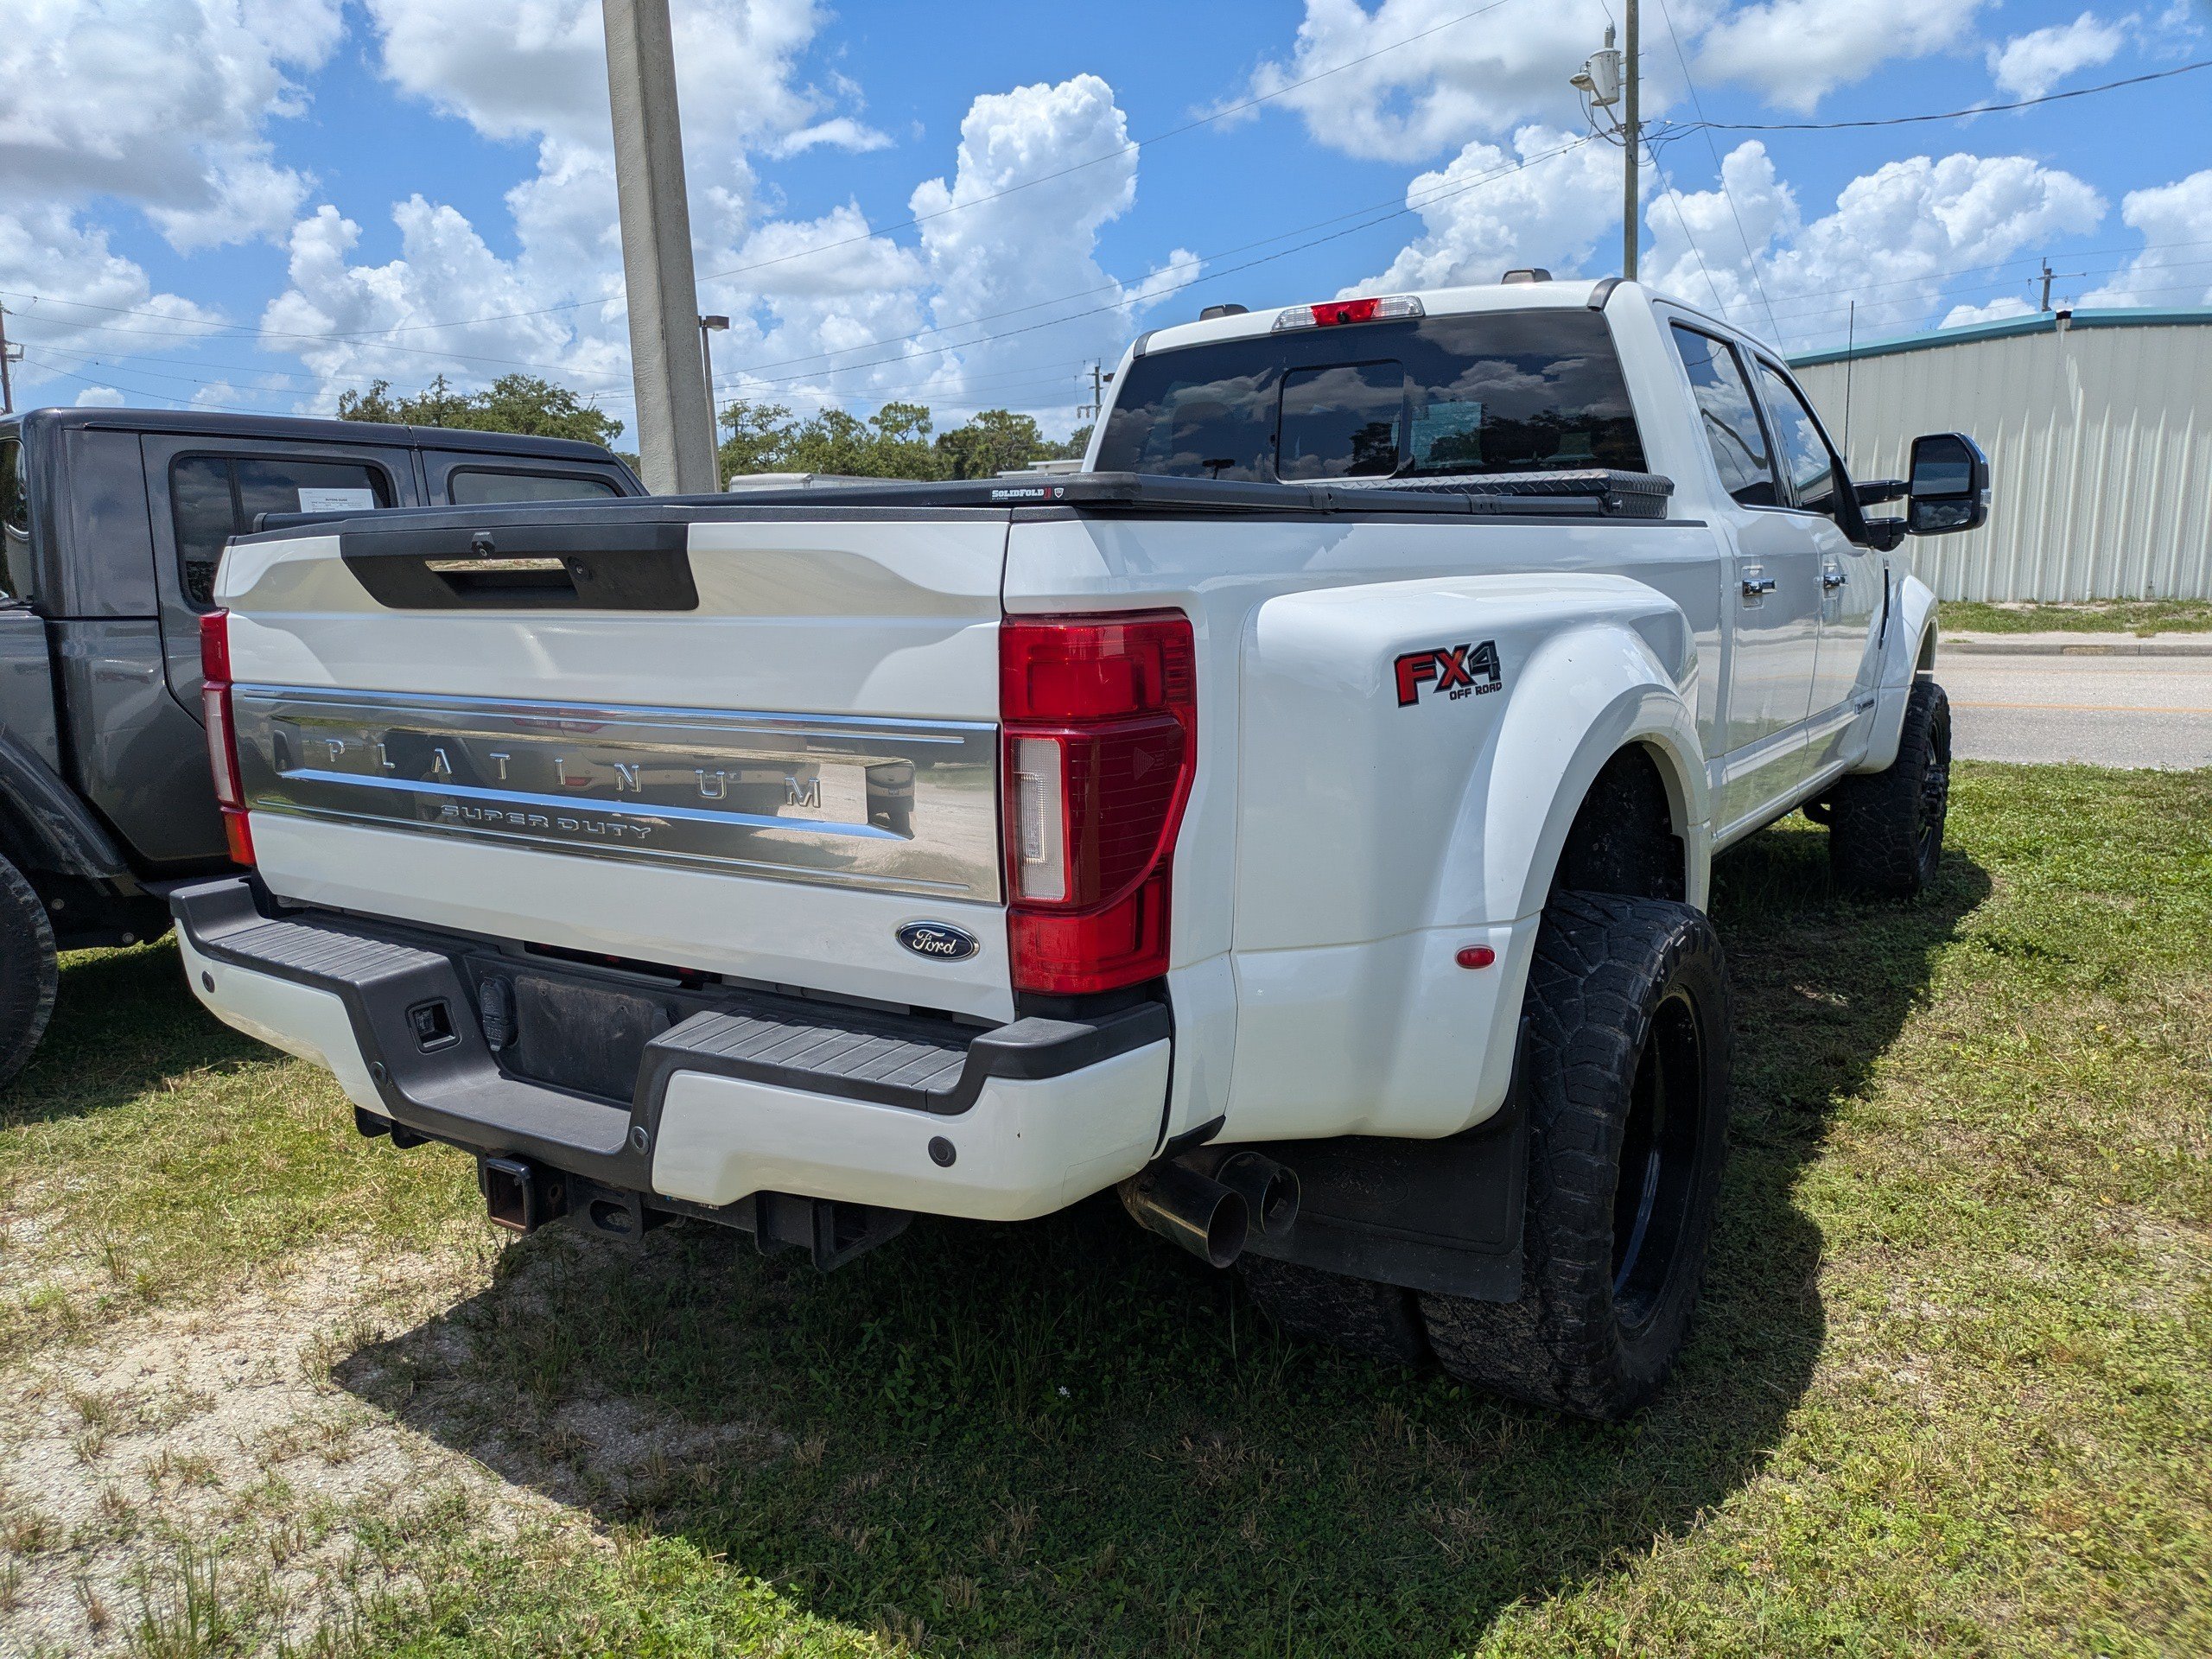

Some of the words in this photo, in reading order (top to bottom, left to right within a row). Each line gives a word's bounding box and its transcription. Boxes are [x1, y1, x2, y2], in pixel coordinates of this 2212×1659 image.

[992, 488, 1044, 498] SOLIDFOLD
[1394, 639, 1501, 708] FX4
[1449, 688, 1471, 701] OFF
[1475, 682, 1503, 696] ROAD
[325, 739, 821, 808] PLATINUM
[441, 804, 549, 828] SUPER
[557, 817, 651, 839] DUTY
[912, 929, 957, 955] Ford
